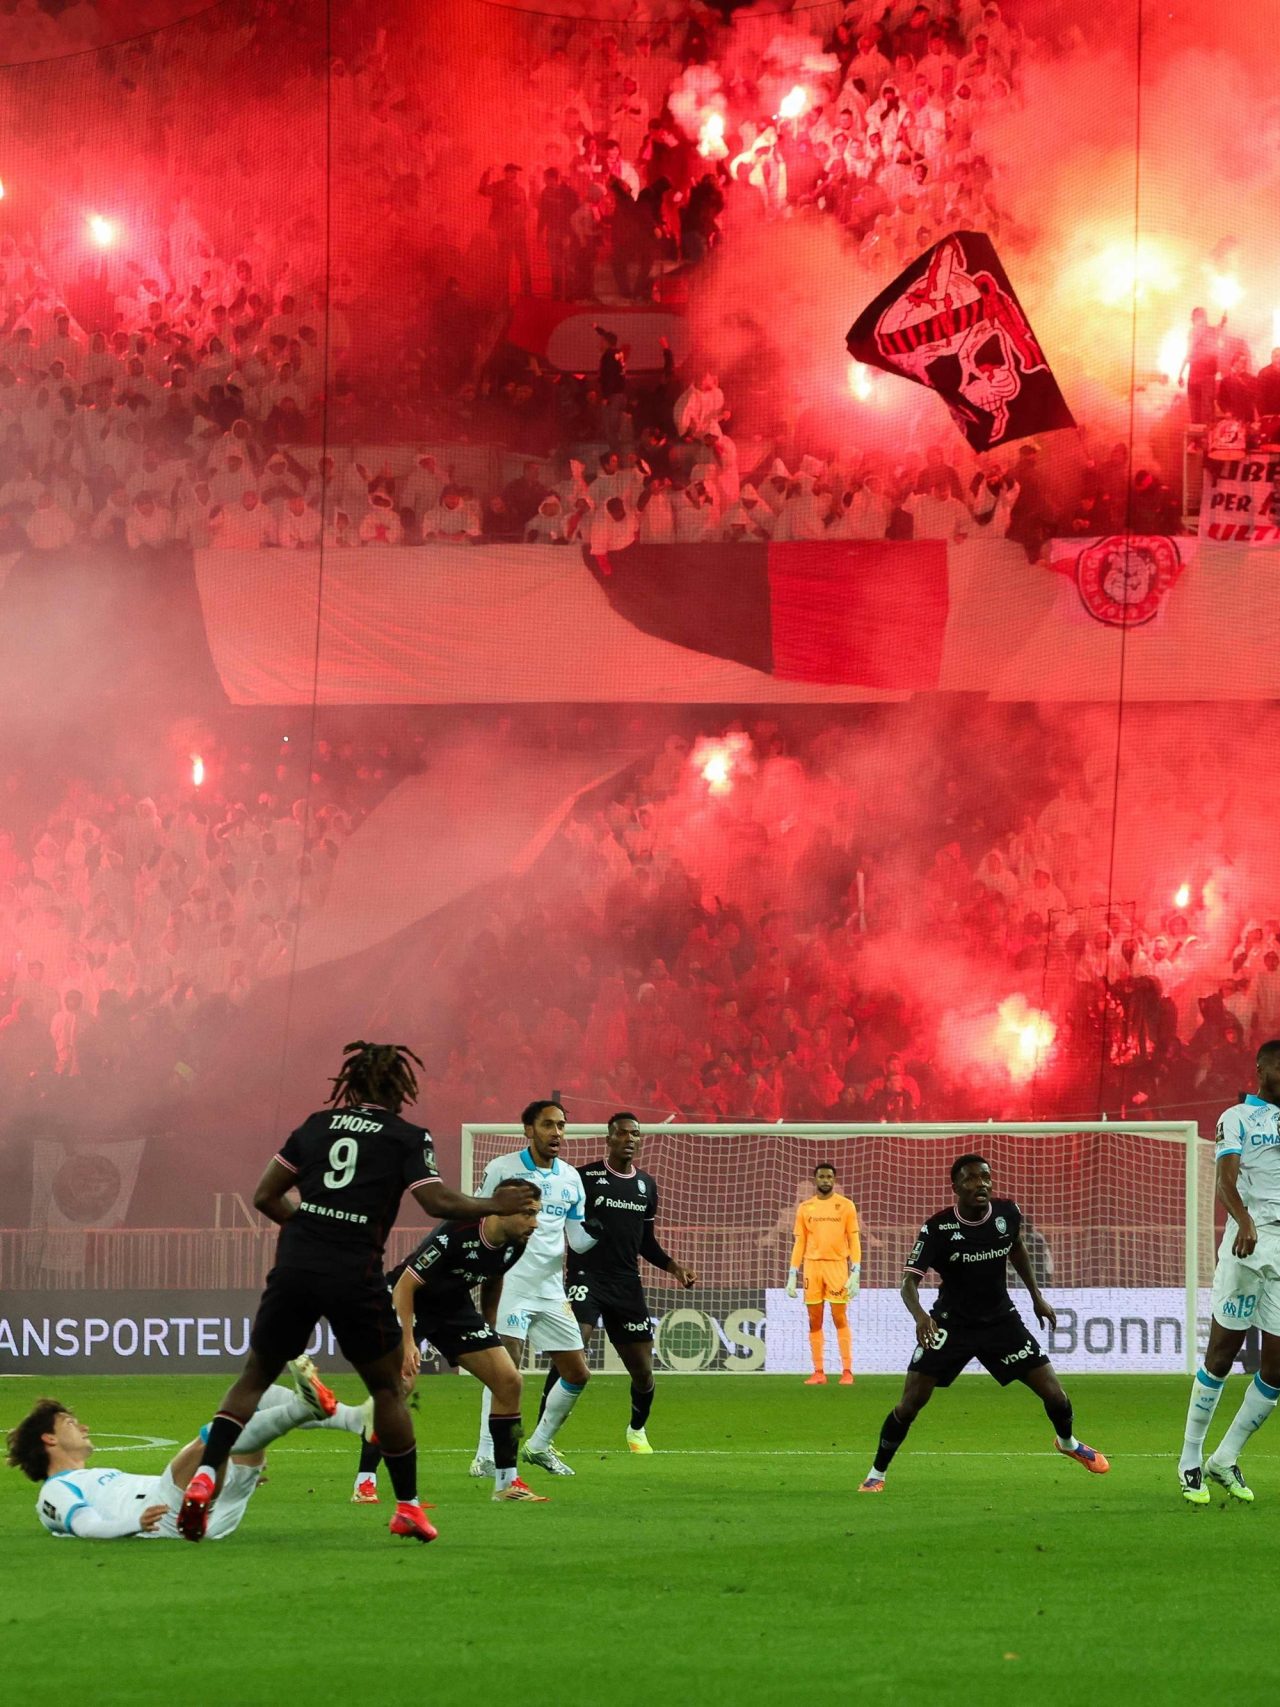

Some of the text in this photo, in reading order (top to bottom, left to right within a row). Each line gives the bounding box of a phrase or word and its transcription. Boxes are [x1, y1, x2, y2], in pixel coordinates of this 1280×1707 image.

[1211, 493, 1252, 512] PER
[329, 1114, 384, 1133] T.MOFFI
[323, 1137, 358, 1189] 9
[938, 1222, 961, 1230] actual
[1237, 1295, 1257, 1318] 19
